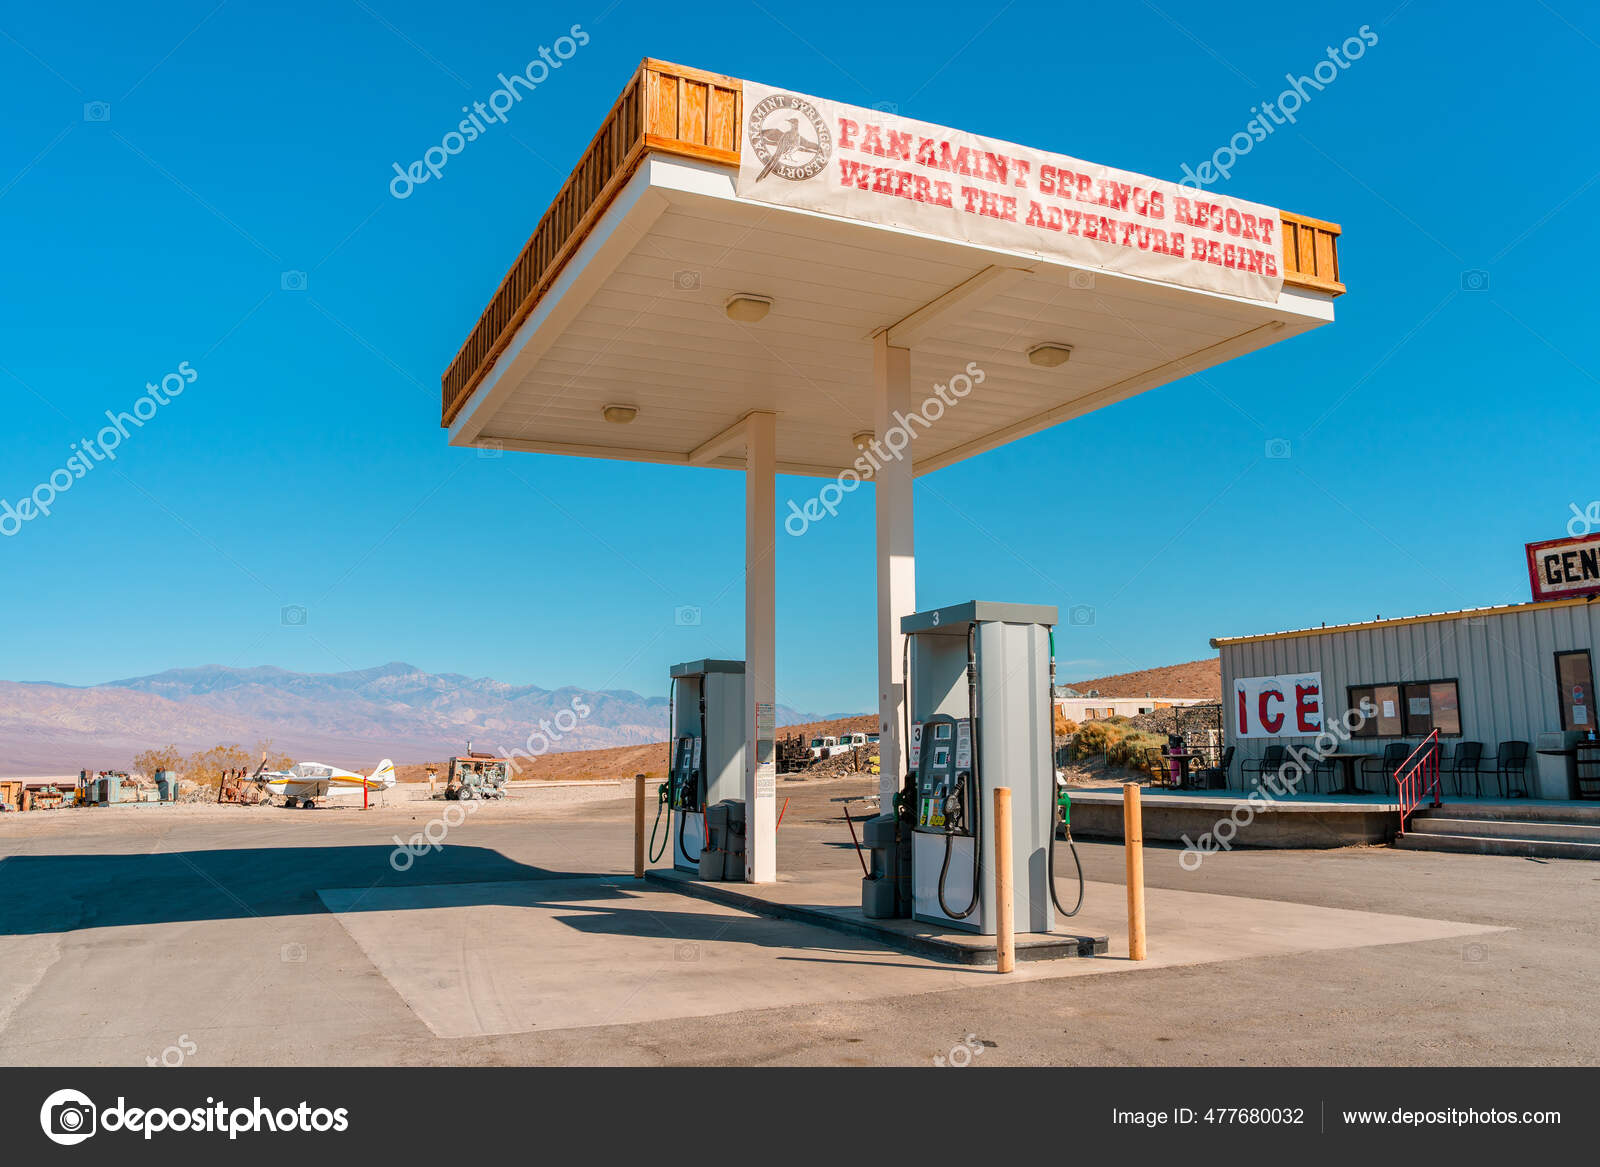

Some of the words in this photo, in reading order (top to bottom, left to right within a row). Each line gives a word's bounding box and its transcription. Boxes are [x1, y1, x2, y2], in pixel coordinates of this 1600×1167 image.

[752, 96, 785, 160] PANAMINT
[791, 98, 830, 151] SPRINGS
[777, 151, 826, 178] RESORT
[838, 117, 1031, 189] PANAMINT
[1040, 164, 1165, 220] SPRINGS
[1173, 196, 1275, 245] RESORT
[839, 158, 953, 208] WHERE
[961, 185, 1017, 222] THE
[1025, 200, 1185, 259] ADVENTURE
[1191, 236, 1278, 277] BEGINS
[1544, 547, 1600, 585] GEN
[932, 611, 940, 626] 3
[1237, 678, 1322, 735] ICE
[915, 728, 921, 741] 3
